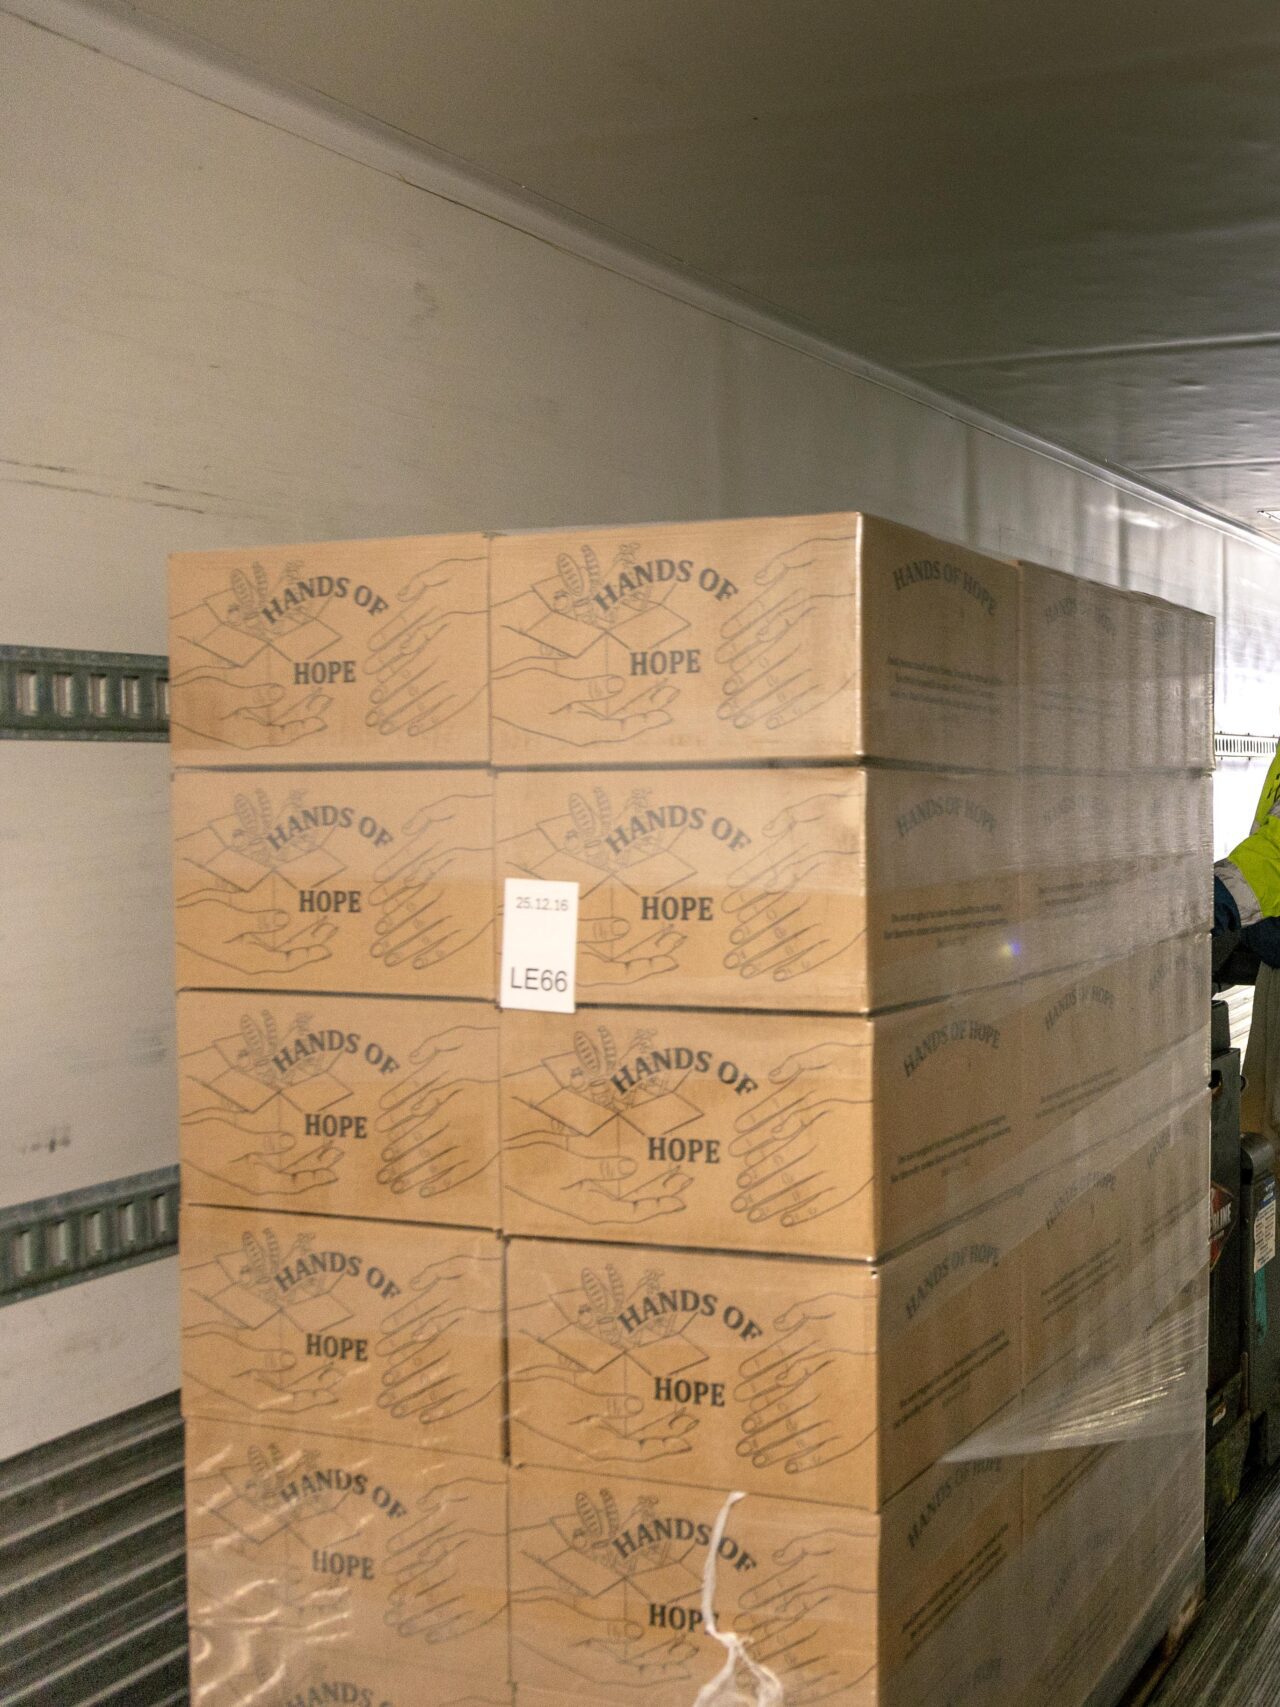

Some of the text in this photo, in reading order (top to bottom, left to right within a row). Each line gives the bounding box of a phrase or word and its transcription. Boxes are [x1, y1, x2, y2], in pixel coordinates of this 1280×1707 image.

[595, 559, 739, 611] HANDS OF
[893, 560, 940, 590] HANDS
[943, 563, 962, 585] OF
[261, 576, 389, 624] HANDS OF
[294, 661, 356, 685] HOPE
[629, 649, 701, 676] HOPE
[265, 805, 394, 852] HANDS OF
[604, 804, 752, 856] HANDS OF
[897, 799, 944, 838] HANDS
[299, 890, 361, 914] HOPE
[515, 896, 569, 912] 25.12.16
[640, 896, 714, 921] HOPE
[510, 966, 568, 993] LE66
[272, 1030, 400, 1077] HANDS OF
[904, 1019, 1001, 1077] HANDS OF HOPE
[610, 1047, 758, 1098] HANDS OF
[304, 1114, 367, 1139] HOPE
[647, 1137, 719, 1164] HOPE
[273, 1251, 401, 1299] HANDS OF
[906, 1259, 948, 1320] HANDS
[617, 1289, 763, 1343] HANDS OF
[305, 1334, 368, 1362] HOPE
[653, 1377, 725, 1406] HOPE
[279, 1470, 408, 1522] HANDS OF
[612, 1518, 757, 1573] HANDS OF
[311, 1551, 374, 1579] HOPE
[649, 1603, 719, 1632] HOP
